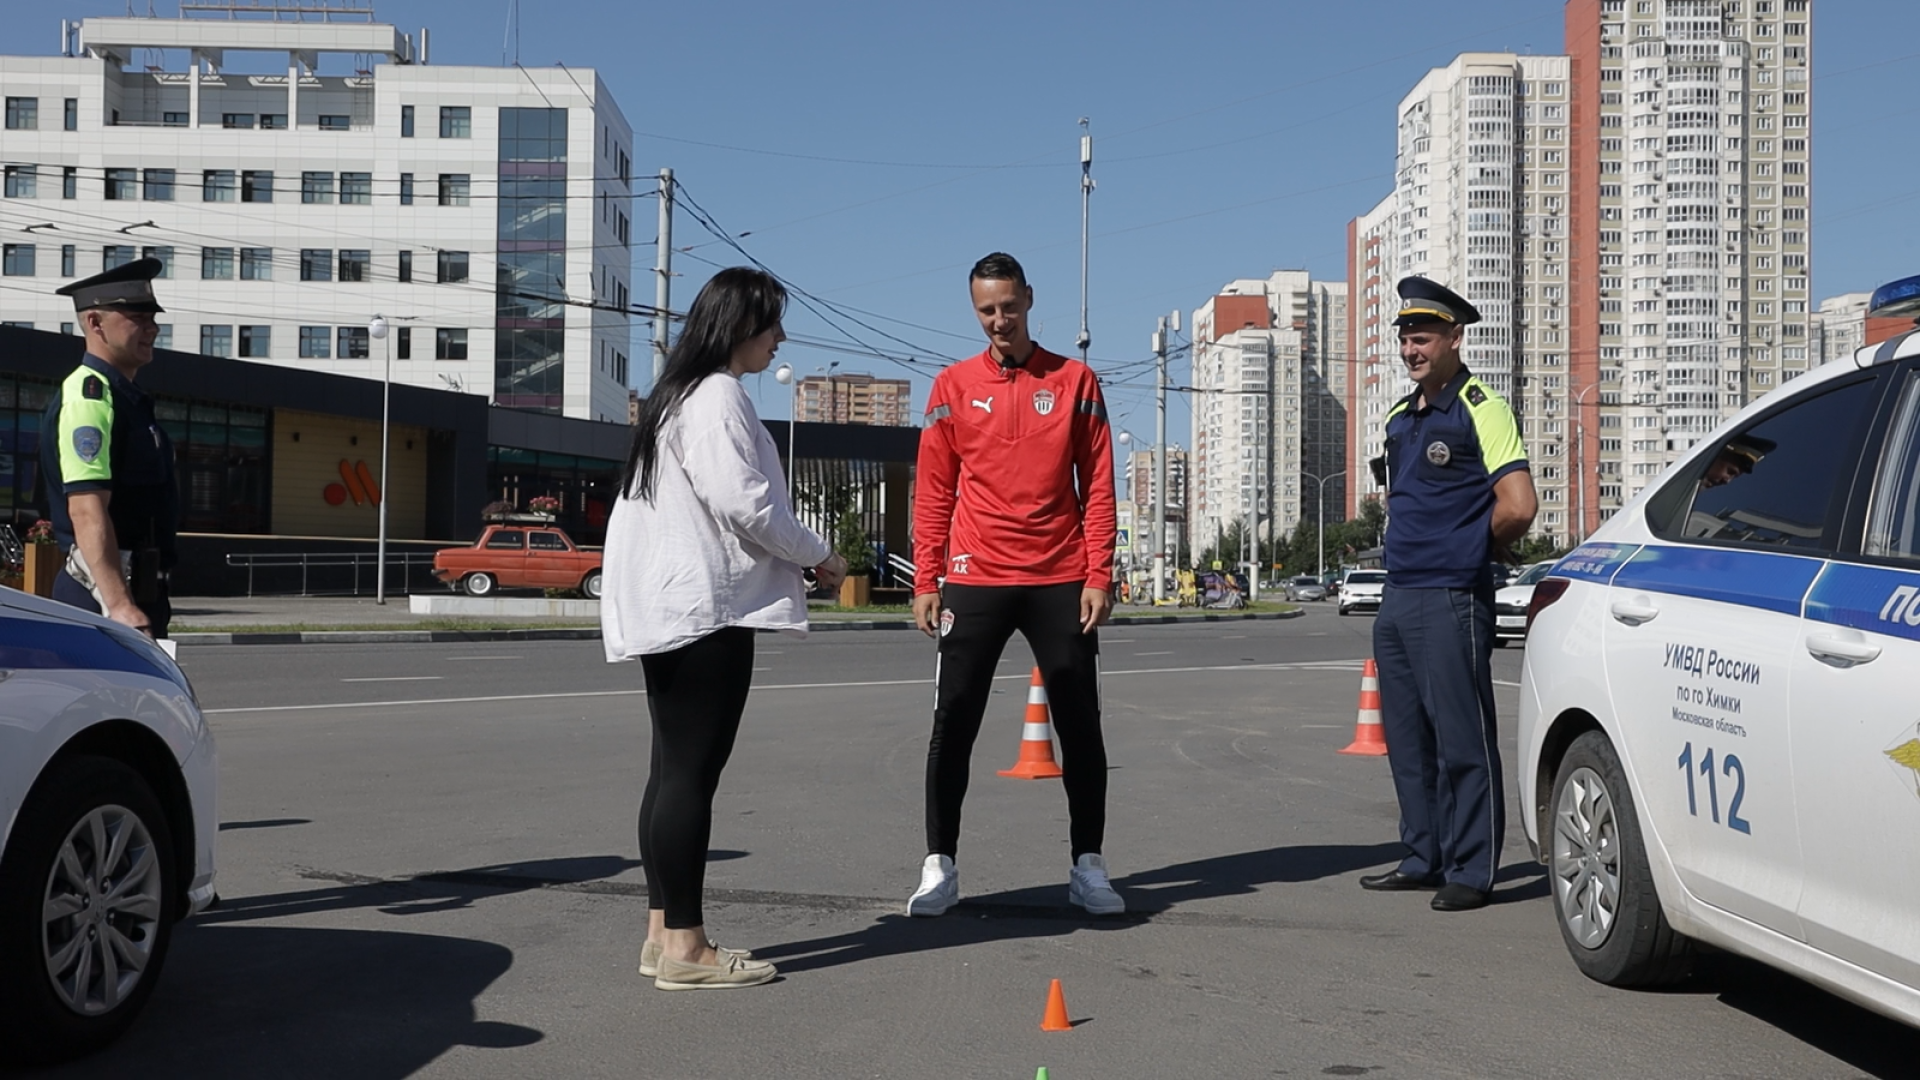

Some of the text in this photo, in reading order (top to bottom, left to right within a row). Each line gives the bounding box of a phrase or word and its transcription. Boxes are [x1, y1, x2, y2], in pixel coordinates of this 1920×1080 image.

[1663, 643, 1760, 685] УМВД России
[1677, 686, 1741, 714] по го Химки
[1672, 706, 1747, 738] Московская область
[1678, 741, 1752, 836] 112
